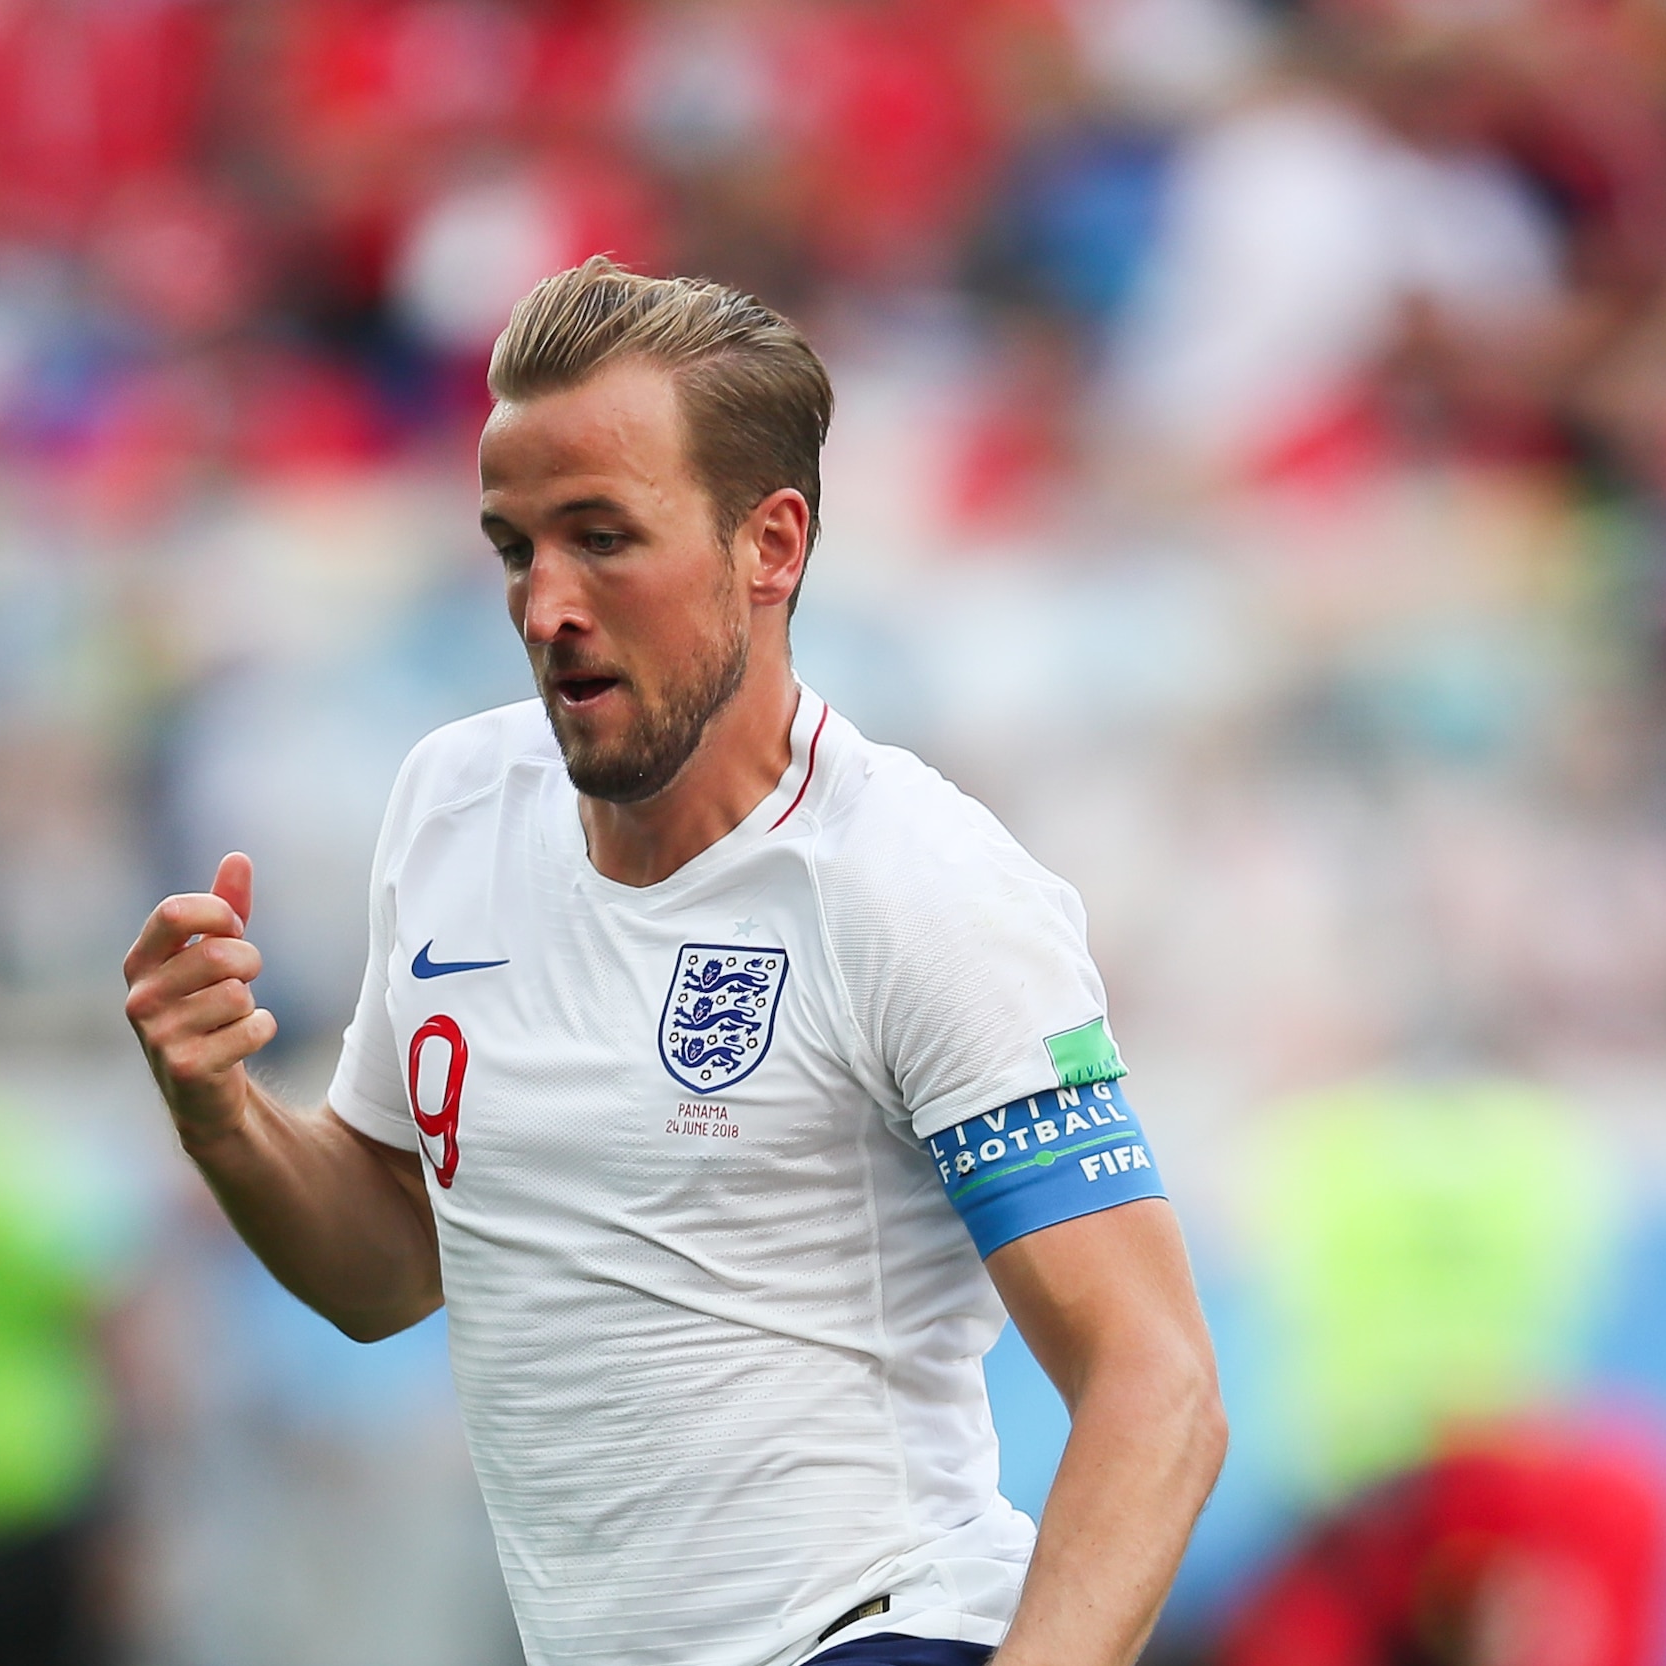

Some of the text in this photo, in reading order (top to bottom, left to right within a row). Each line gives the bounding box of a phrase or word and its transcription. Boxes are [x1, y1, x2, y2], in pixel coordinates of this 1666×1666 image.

[408, 1014, 469, 1190] 9
[677, 1102, 728, 1120] PANAMA
[930, 1081, 1113, 1160] LIVING
[665, 1119, 739, 1139] 24 JUNE 2018
[1079, 1145, 1152, 1182] FIFA
